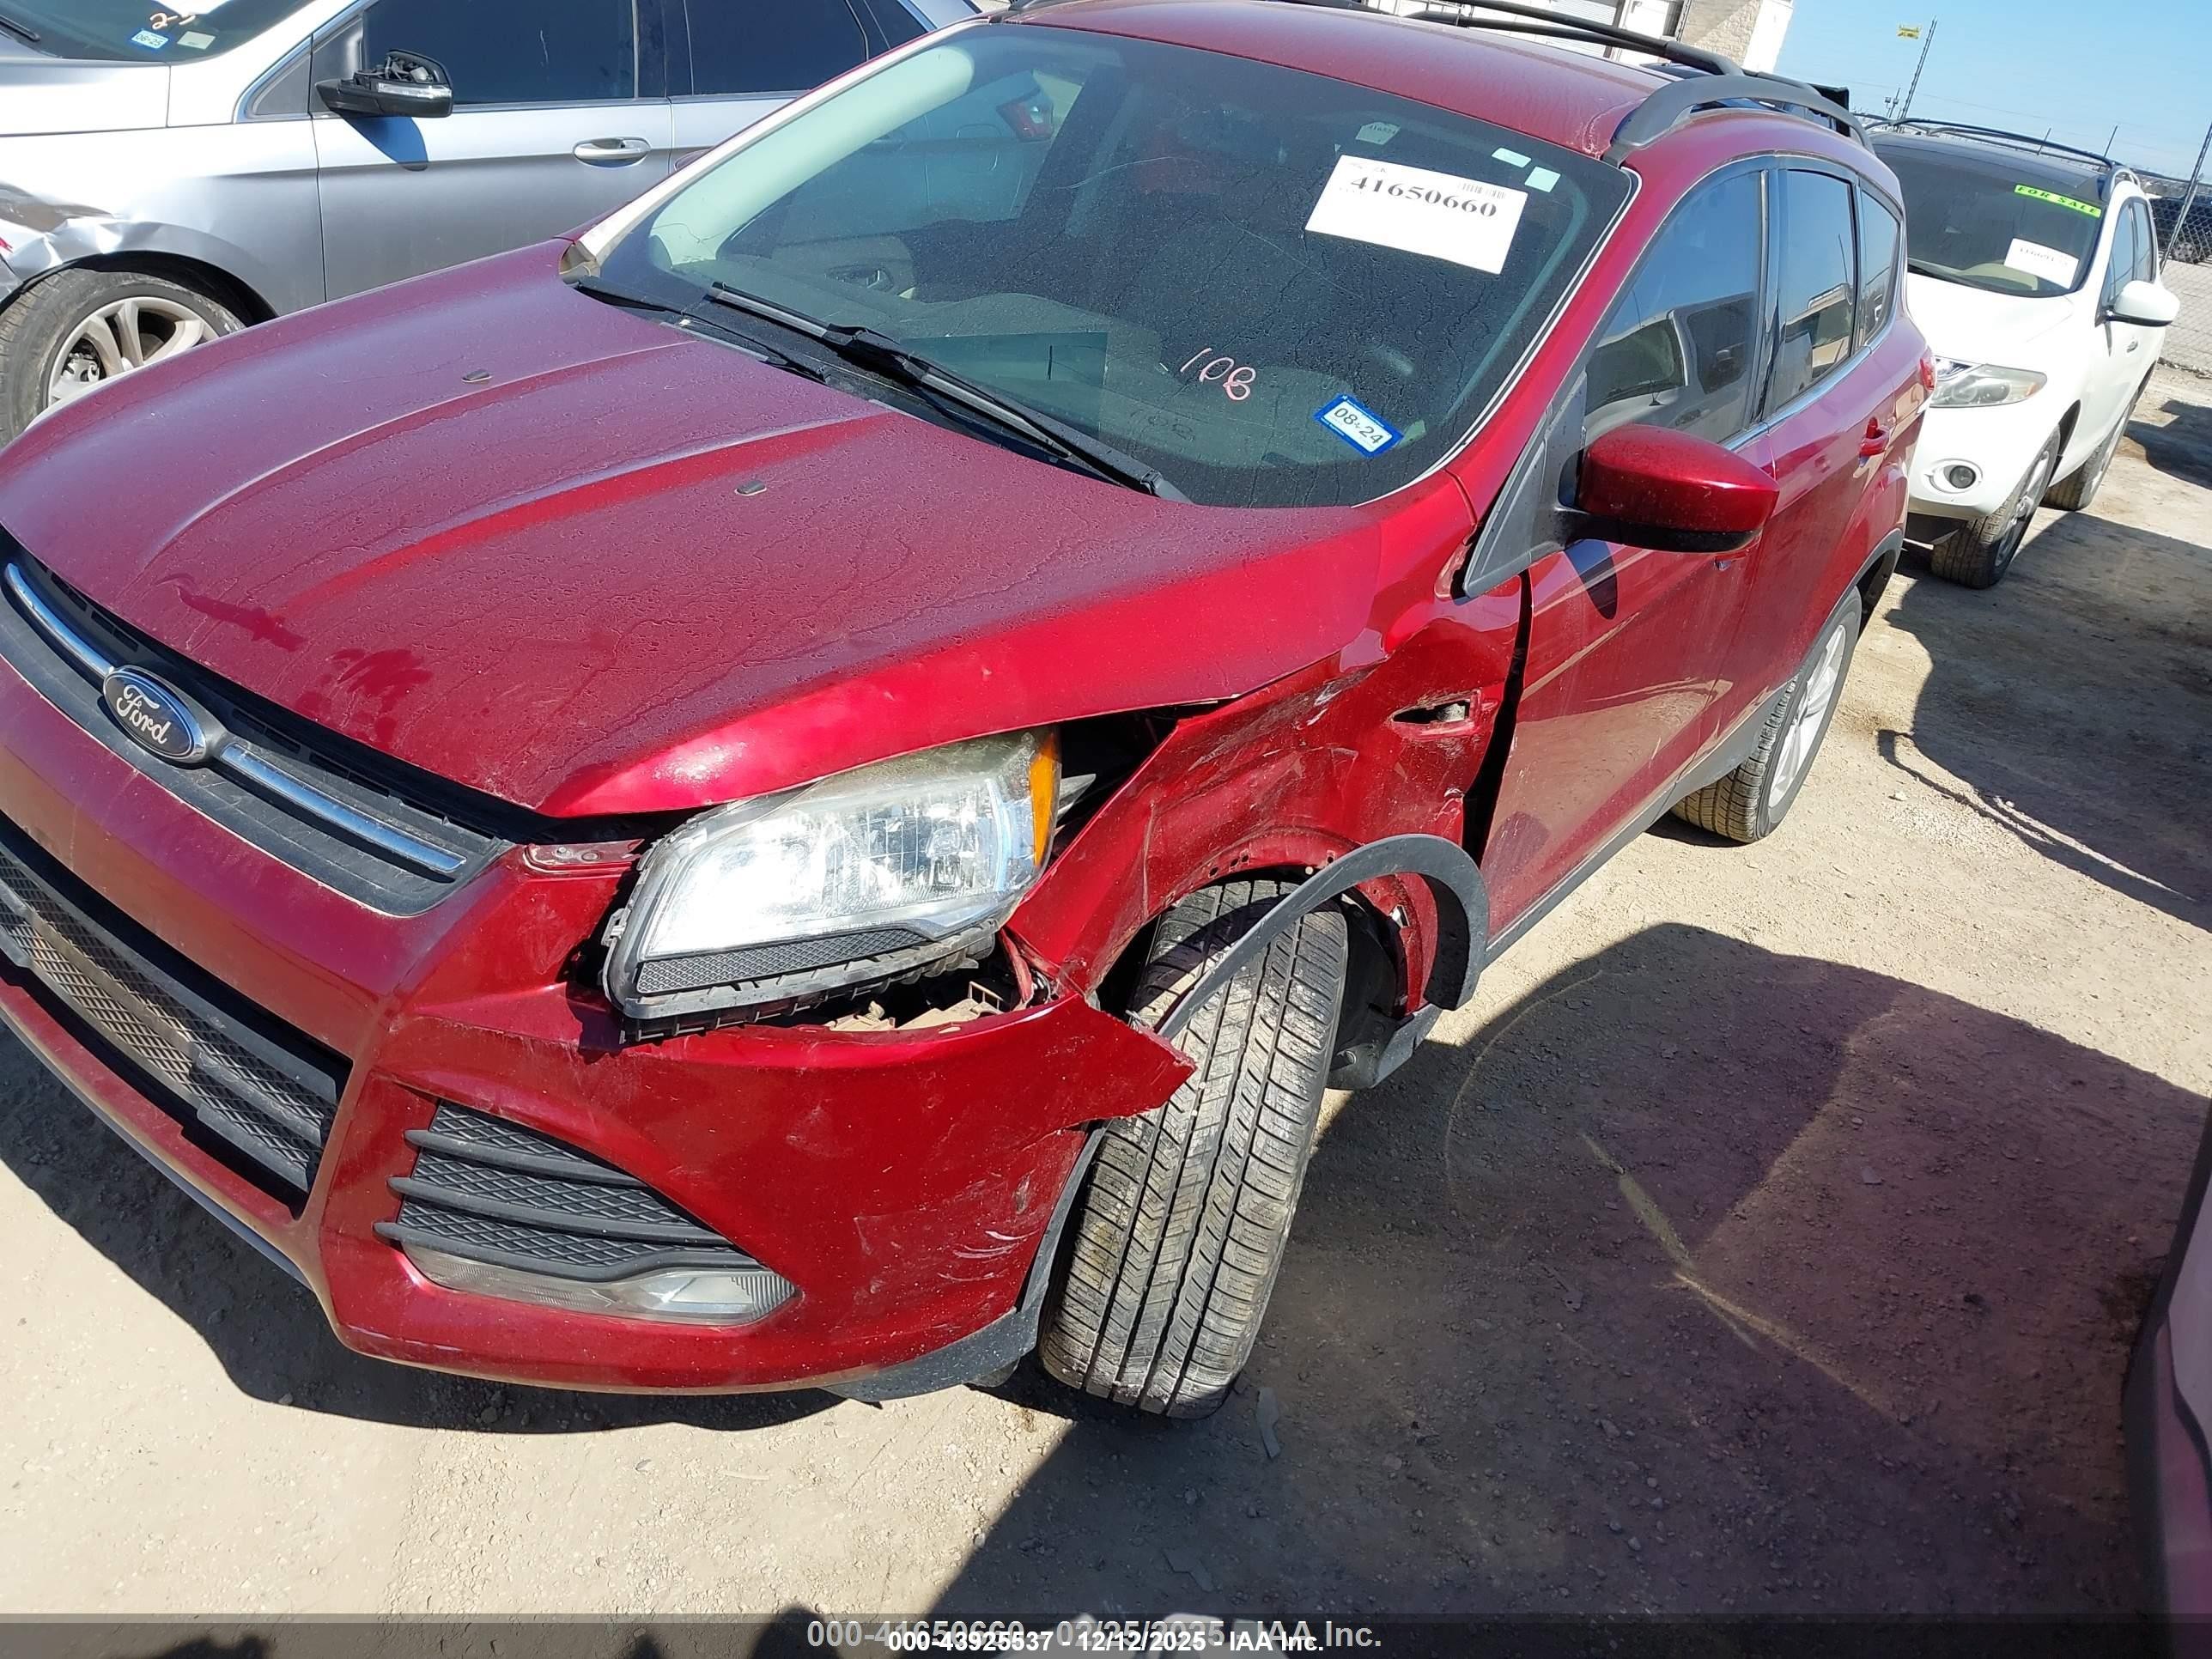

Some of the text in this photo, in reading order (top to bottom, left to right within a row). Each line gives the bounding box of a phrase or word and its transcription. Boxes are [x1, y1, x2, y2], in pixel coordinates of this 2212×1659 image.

[1350, 176, 1498, 217] 41650660
[2018, 186, 2098, 214] FOR SALE
[116, 684, 172, 744] Ford
